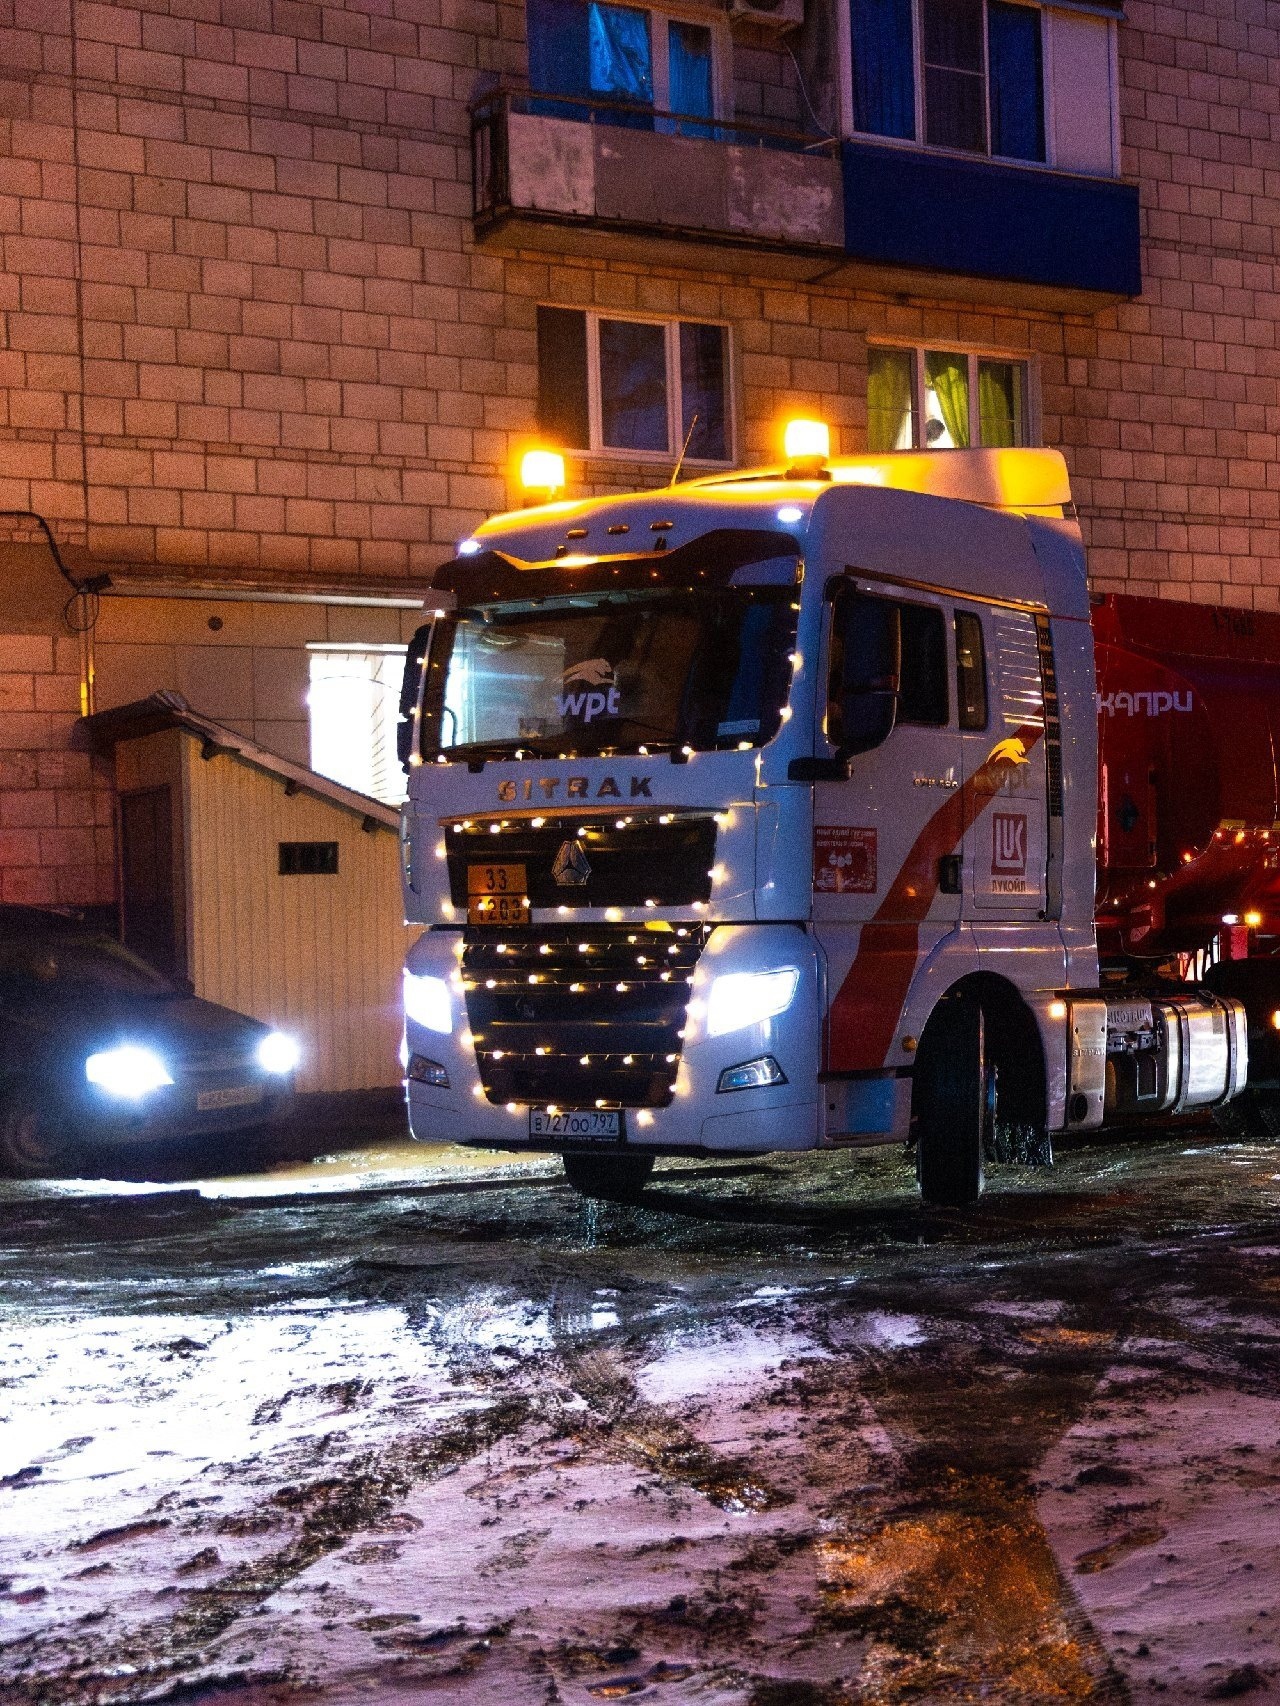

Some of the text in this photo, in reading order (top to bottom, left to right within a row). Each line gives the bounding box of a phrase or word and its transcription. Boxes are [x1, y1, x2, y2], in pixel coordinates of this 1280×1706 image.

[554, 687, 621, 723] wpt
[498, 776, 653, 802] SITRAK
[486, 868, 507, 890] 33
[479, 898, 520, 921] 1203
